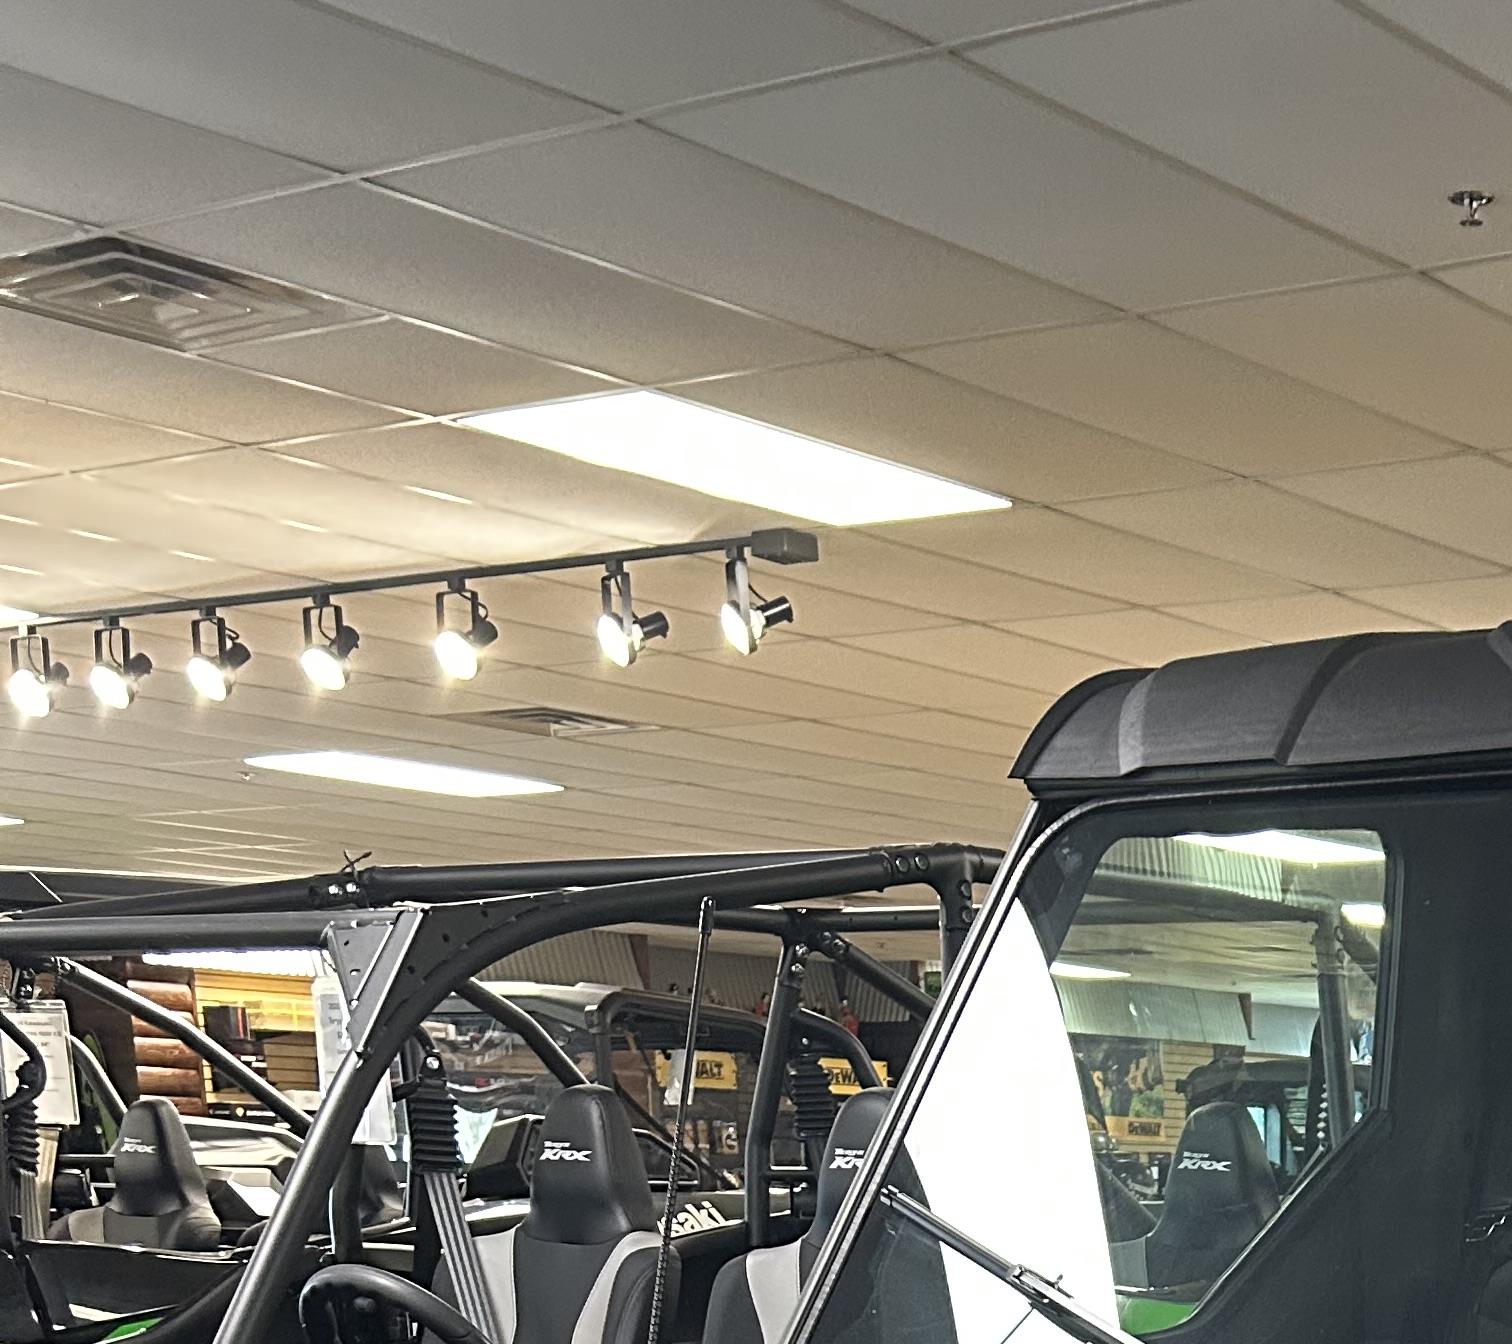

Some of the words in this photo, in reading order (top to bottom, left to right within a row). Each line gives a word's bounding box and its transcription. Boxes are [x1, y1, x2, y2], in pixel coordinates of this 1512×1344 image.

[695, 1061, 723, 1079] ALT
[539, 1149, 592, 1161] KRX
[829, 1156, 864, 1169] KR
[1177, 1158, 1232, 1171] KRX
